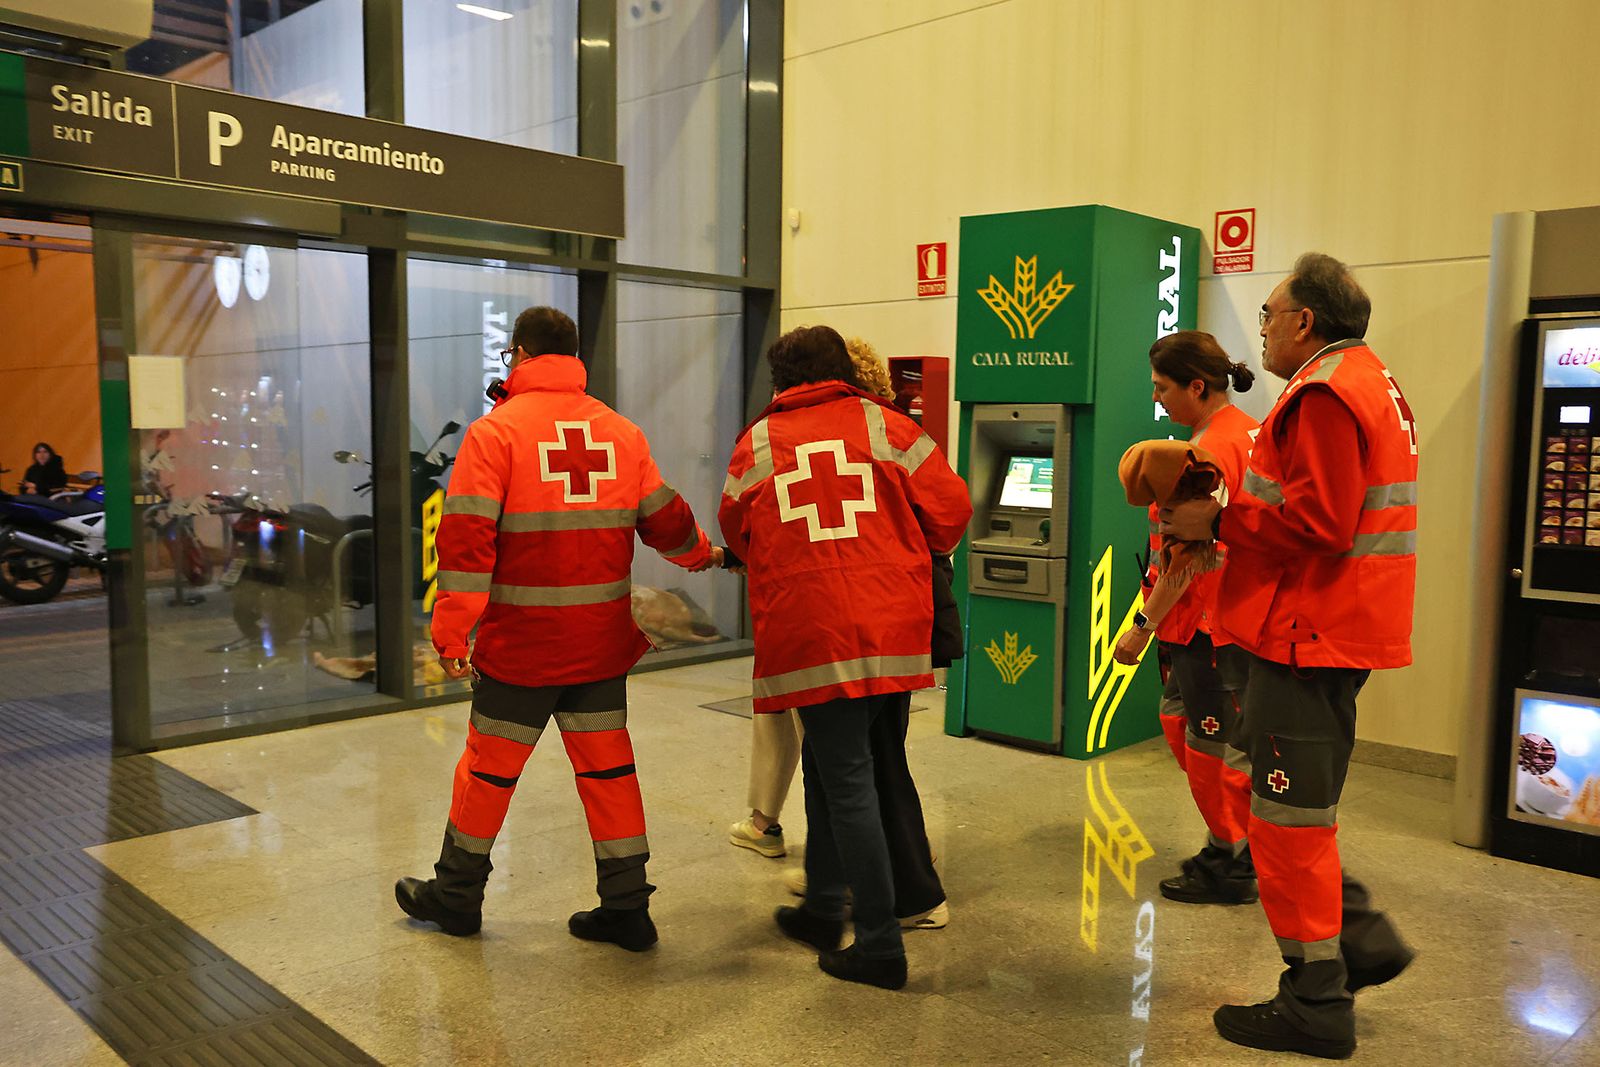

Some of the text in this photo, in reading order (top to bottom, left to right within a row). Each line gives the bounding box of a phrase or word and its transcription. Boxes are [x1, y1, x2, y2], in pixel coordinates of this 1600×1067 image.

[51, 84, 153, 128] Salida
[53, 125, 94, 145] EXIT
[207, 110, 243, 166] P
[270, 124, 445, 176] Aparcamiento
[270, 160, 336, 182] PARKING
[1016, 351, 1073, 366] RURAL
